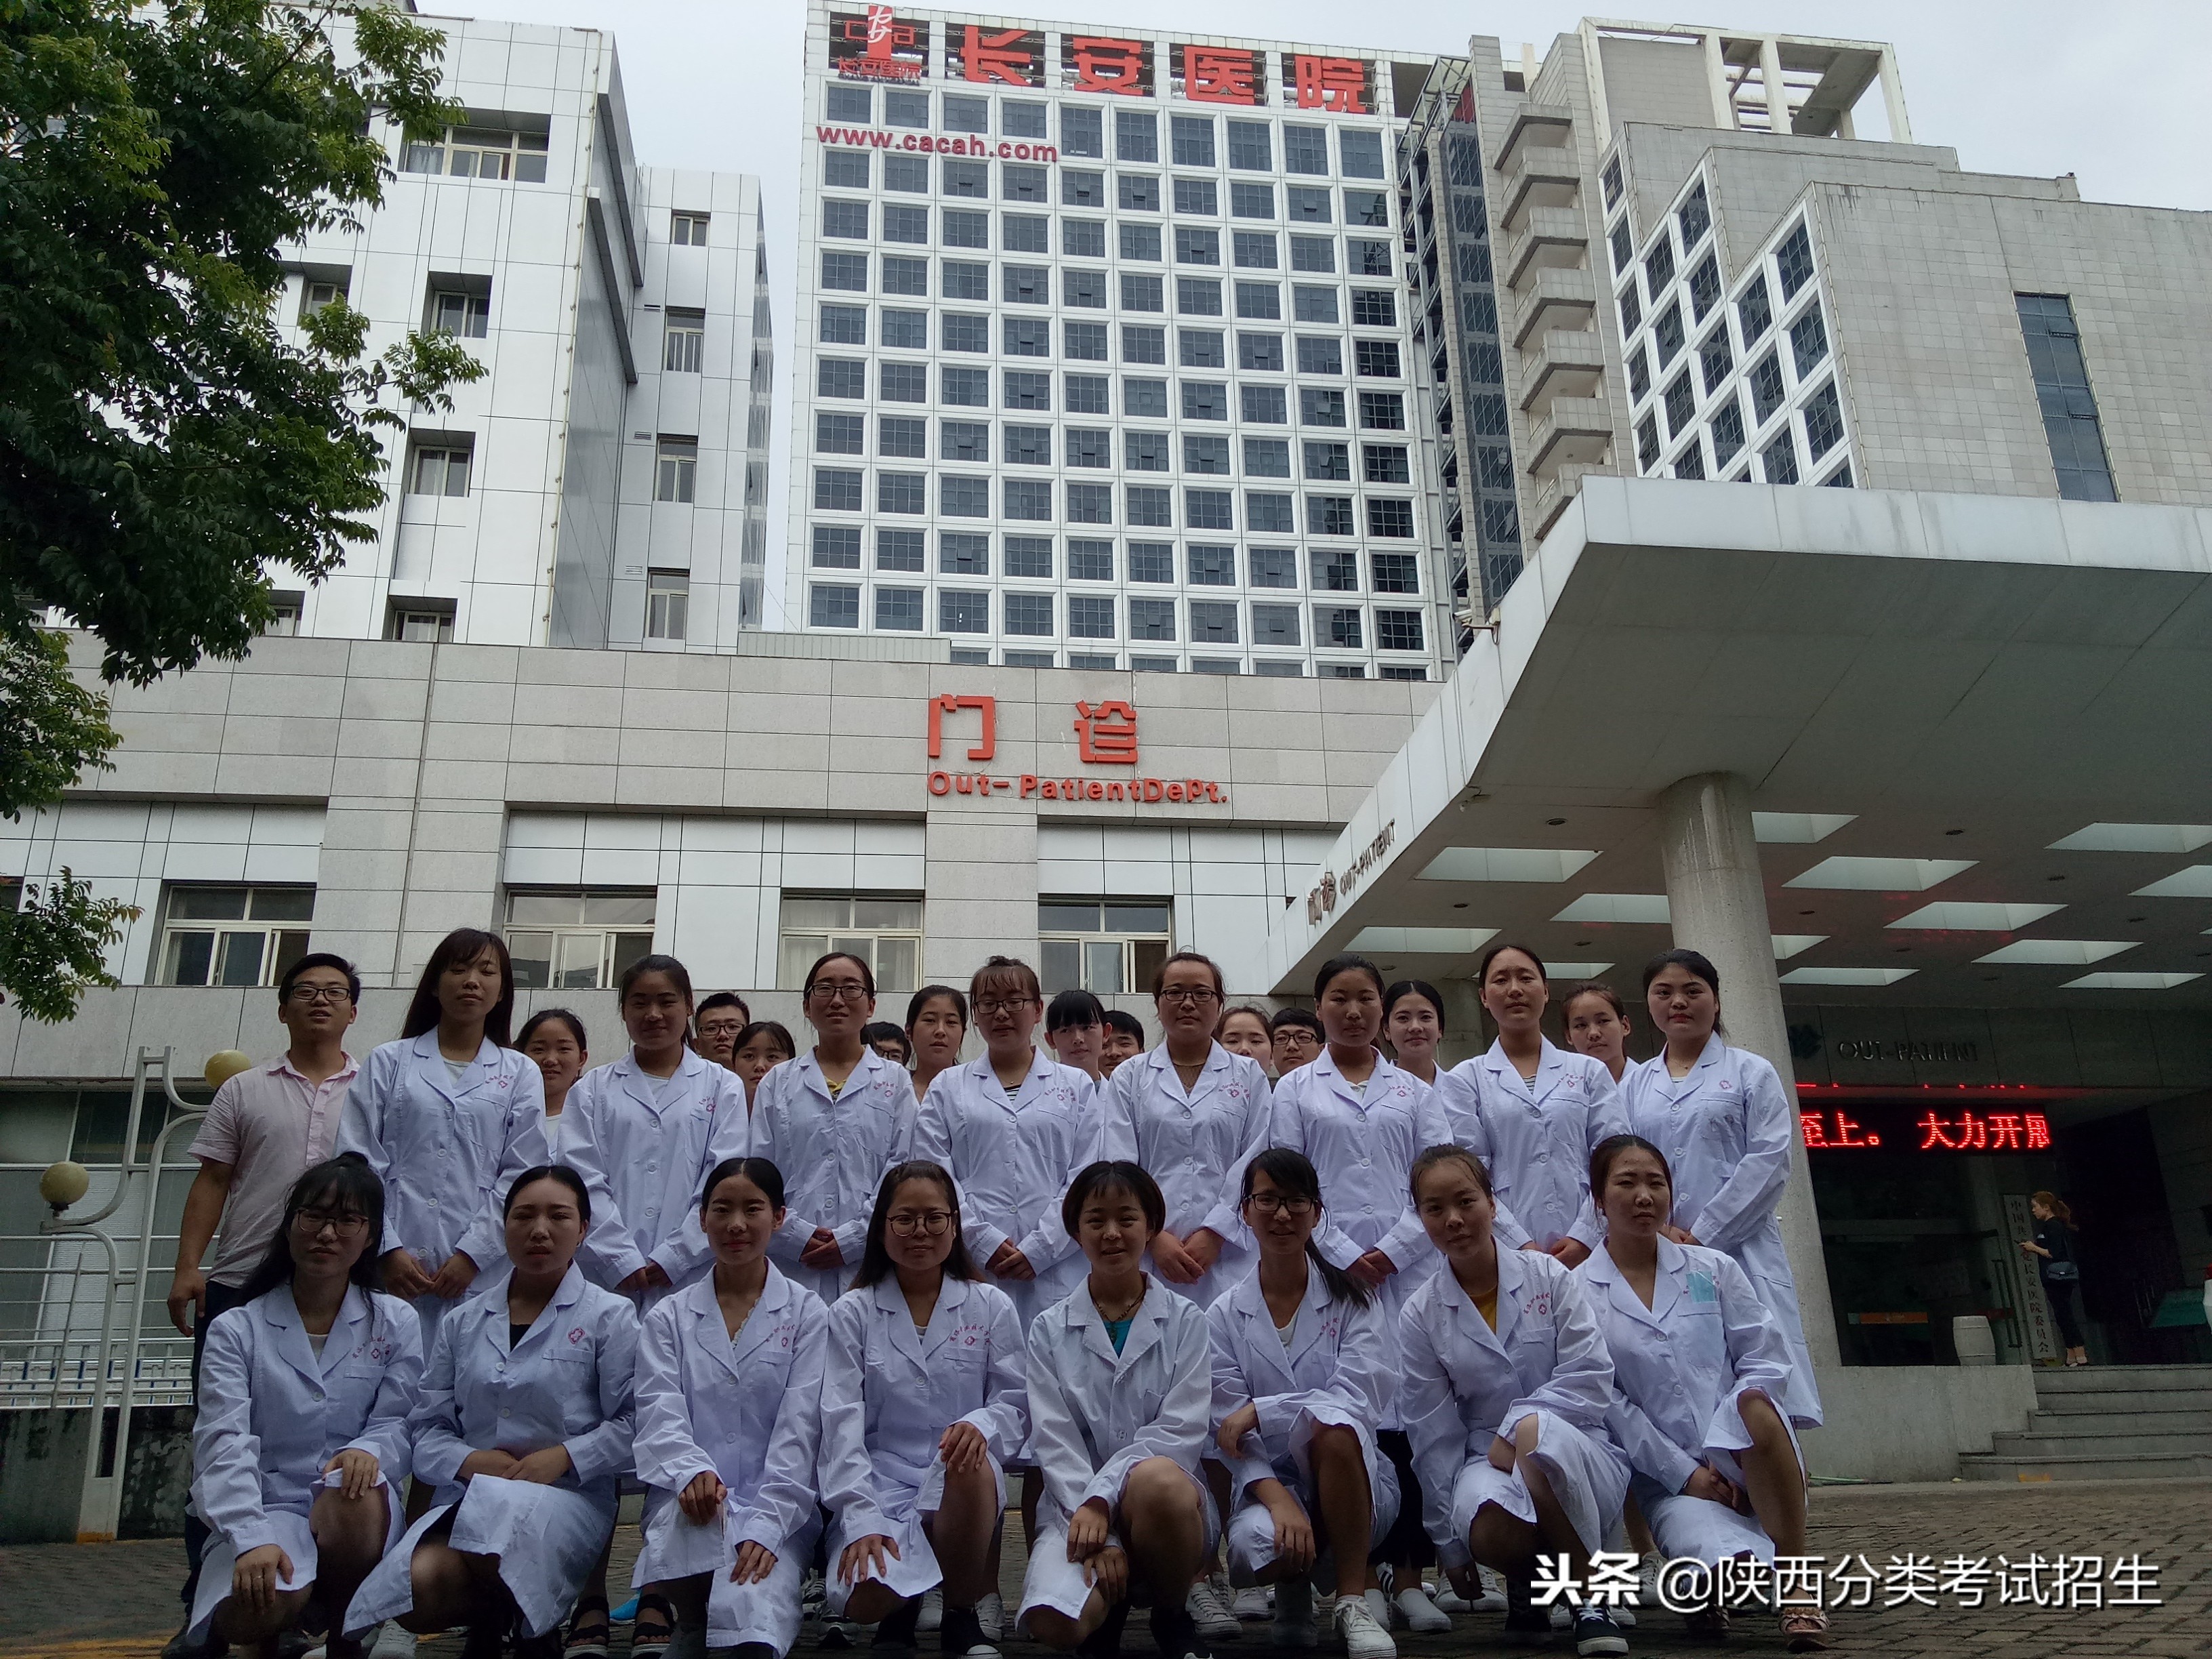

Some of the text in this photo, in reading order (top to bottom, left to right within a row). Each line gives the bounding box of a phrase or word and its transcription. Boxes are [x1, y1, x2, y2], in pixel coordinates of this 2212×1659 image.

[960, 26, 1366, 114] 长安医院
[816, 126, 1057, 163] www.cacah.com
[928, 771, 1010, 796] Out-
[2010, 1200, 2049, 1354] 中国共党长安医院委员会
